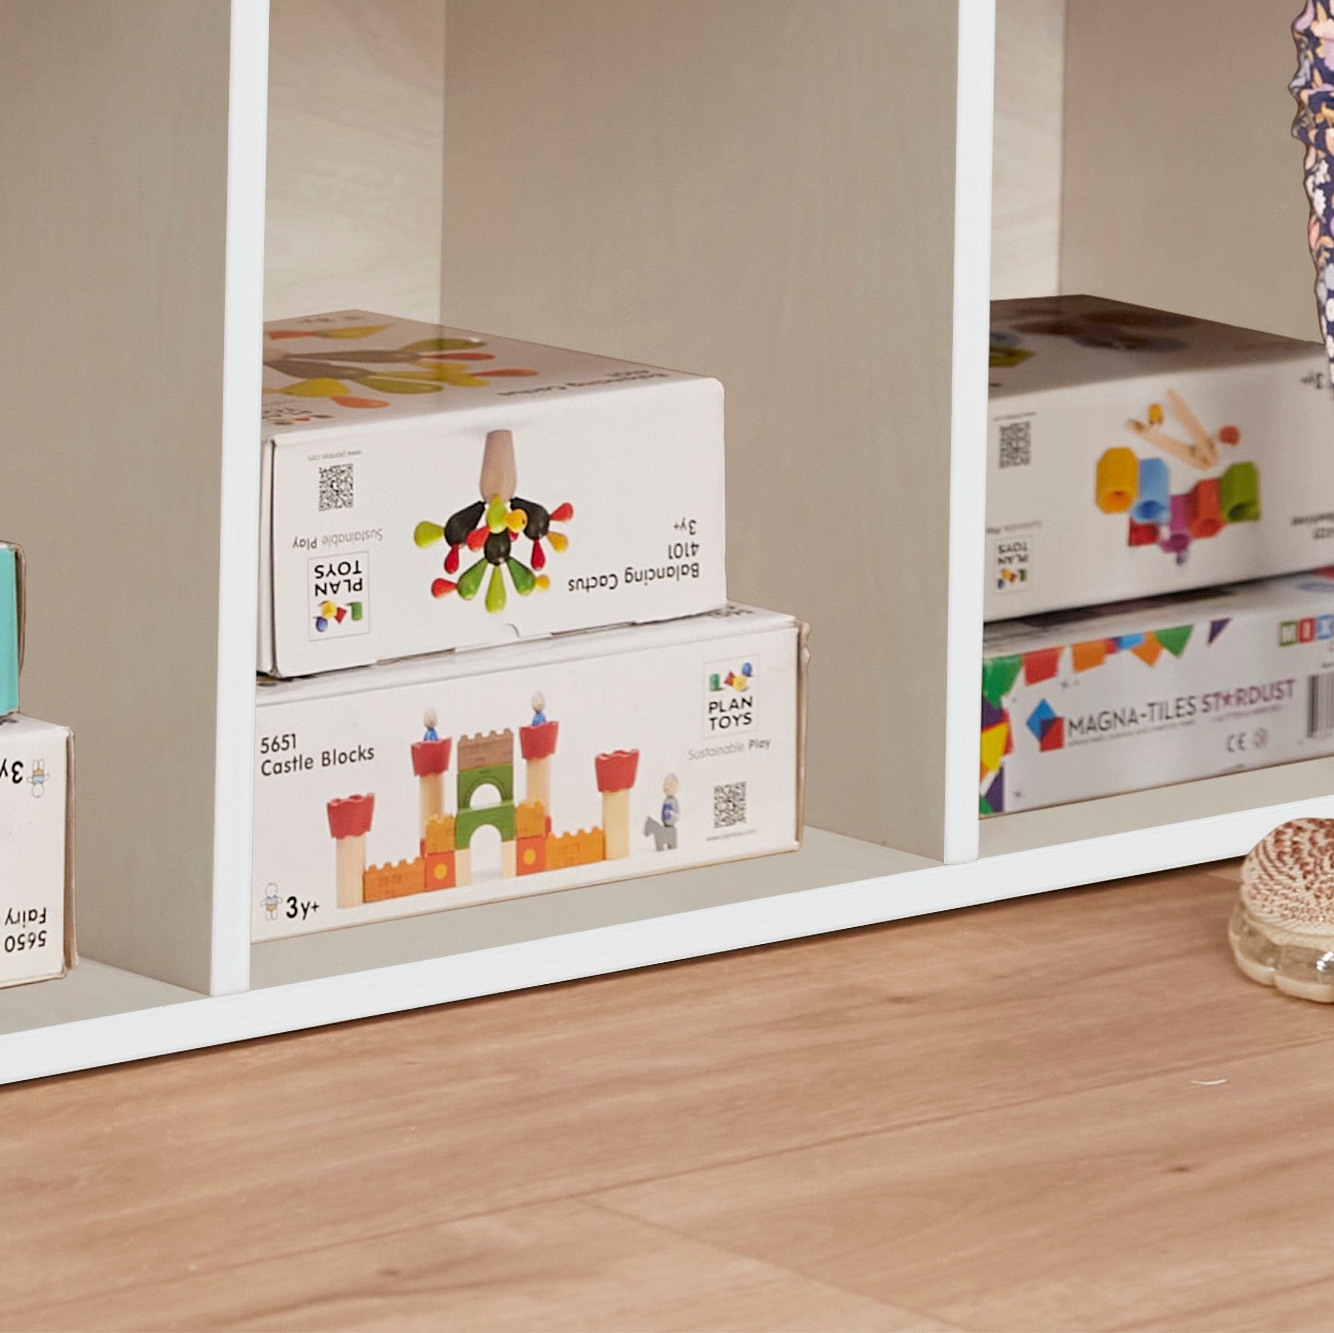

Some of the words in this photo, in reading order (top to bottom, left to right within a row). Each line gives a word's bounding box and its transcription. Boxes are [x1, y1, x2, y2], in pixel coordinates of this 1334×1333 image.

[674, 517, 697, 536] 3y+
[291, 536, 318, 550] Play
[668, 541, 699, 560] 4101
[314, 560, 362, 579] TOYS
[624, 563, 699, 586] Balancing
[315, 578, 363, 597] PLAN
[567, 573, 618, 593] Cactus
[708, 696, 753, 714] PLAN
[709, 712, 752, 730] TOYS
[1067, 694, 1198, 739] MAGNA-TILES
[260, 733, 297, 754] 5651
[748, 739, 771, 751] Play
[261, 751, 314, 777] Castle
[322, 744, 375, 768] Blocks
[4, 907, 47, 928] Fairy
[286, 896, 320, 920] 3y+
[4, 929, 47, 953] 5650
